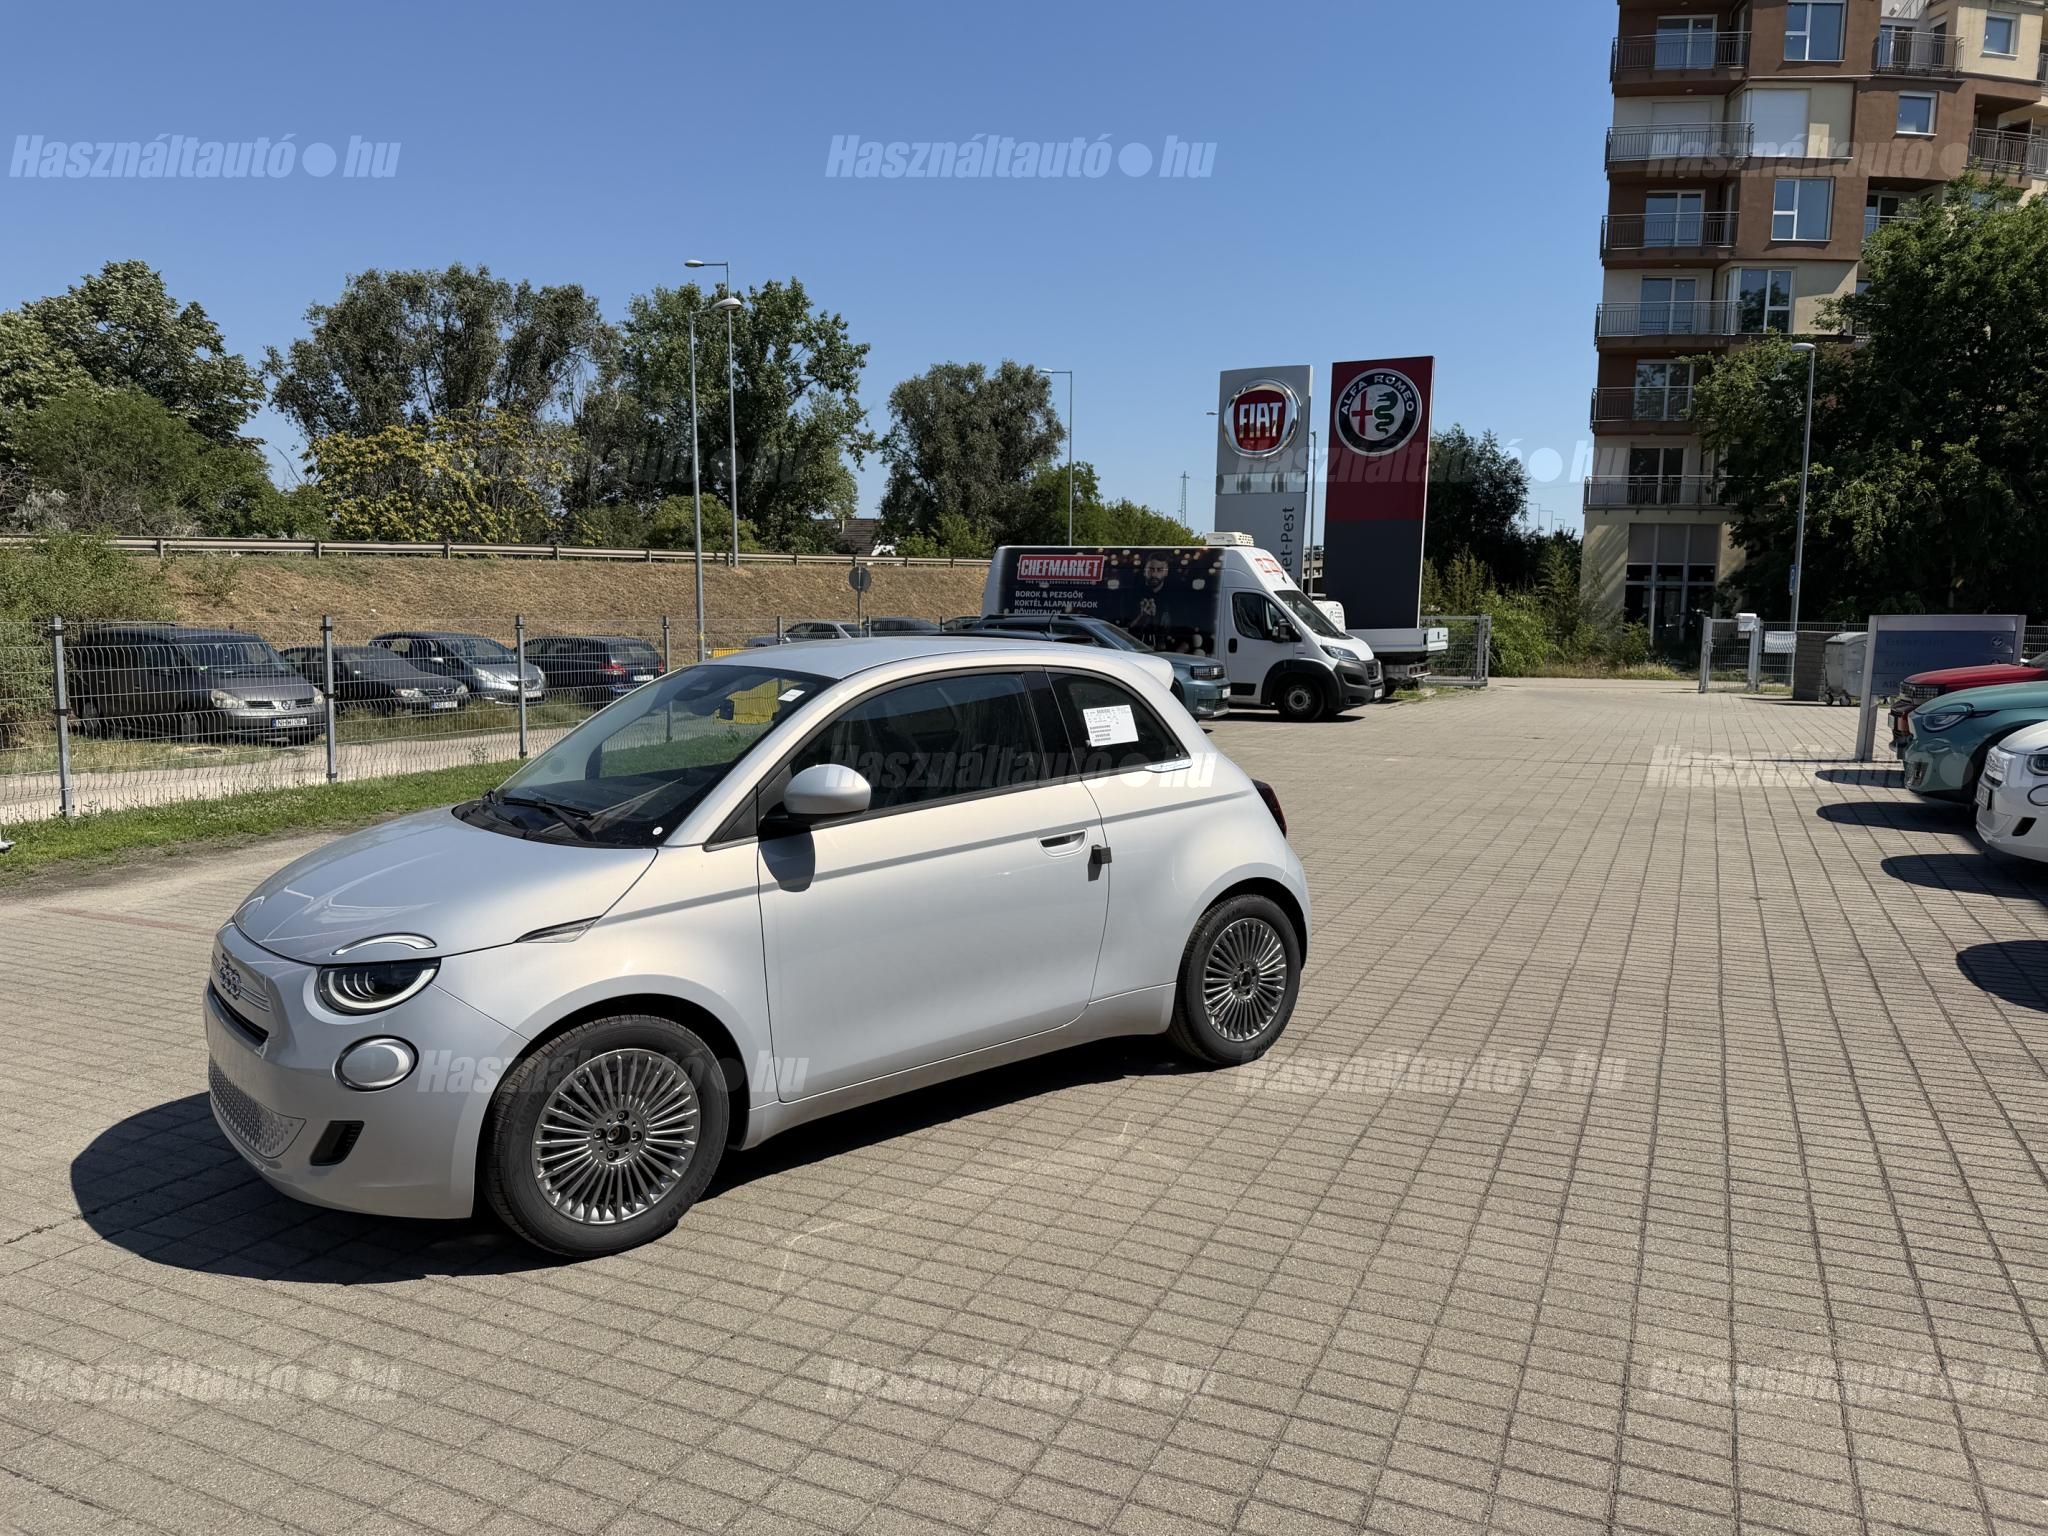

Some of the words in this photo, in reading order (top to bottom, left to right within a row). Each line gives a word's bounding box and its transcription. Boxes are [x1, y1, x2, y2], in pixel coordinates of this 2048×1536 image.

[1341, 381, 1369, 415] ALFA
[1374, 375, 1415, 412] ROMEO
[1238, 402, 1283, 438] FIAT
[1281, 506, 1295, 572] et-Pest
[1020, 559, 1100, 577] CHEFMARKET
[1014, 598, 1041, 607] KOKTÉL
[1043, 600, 1098, 608] ALAPANYAGOK
[1015, 590, 1040, 598] BOROK
